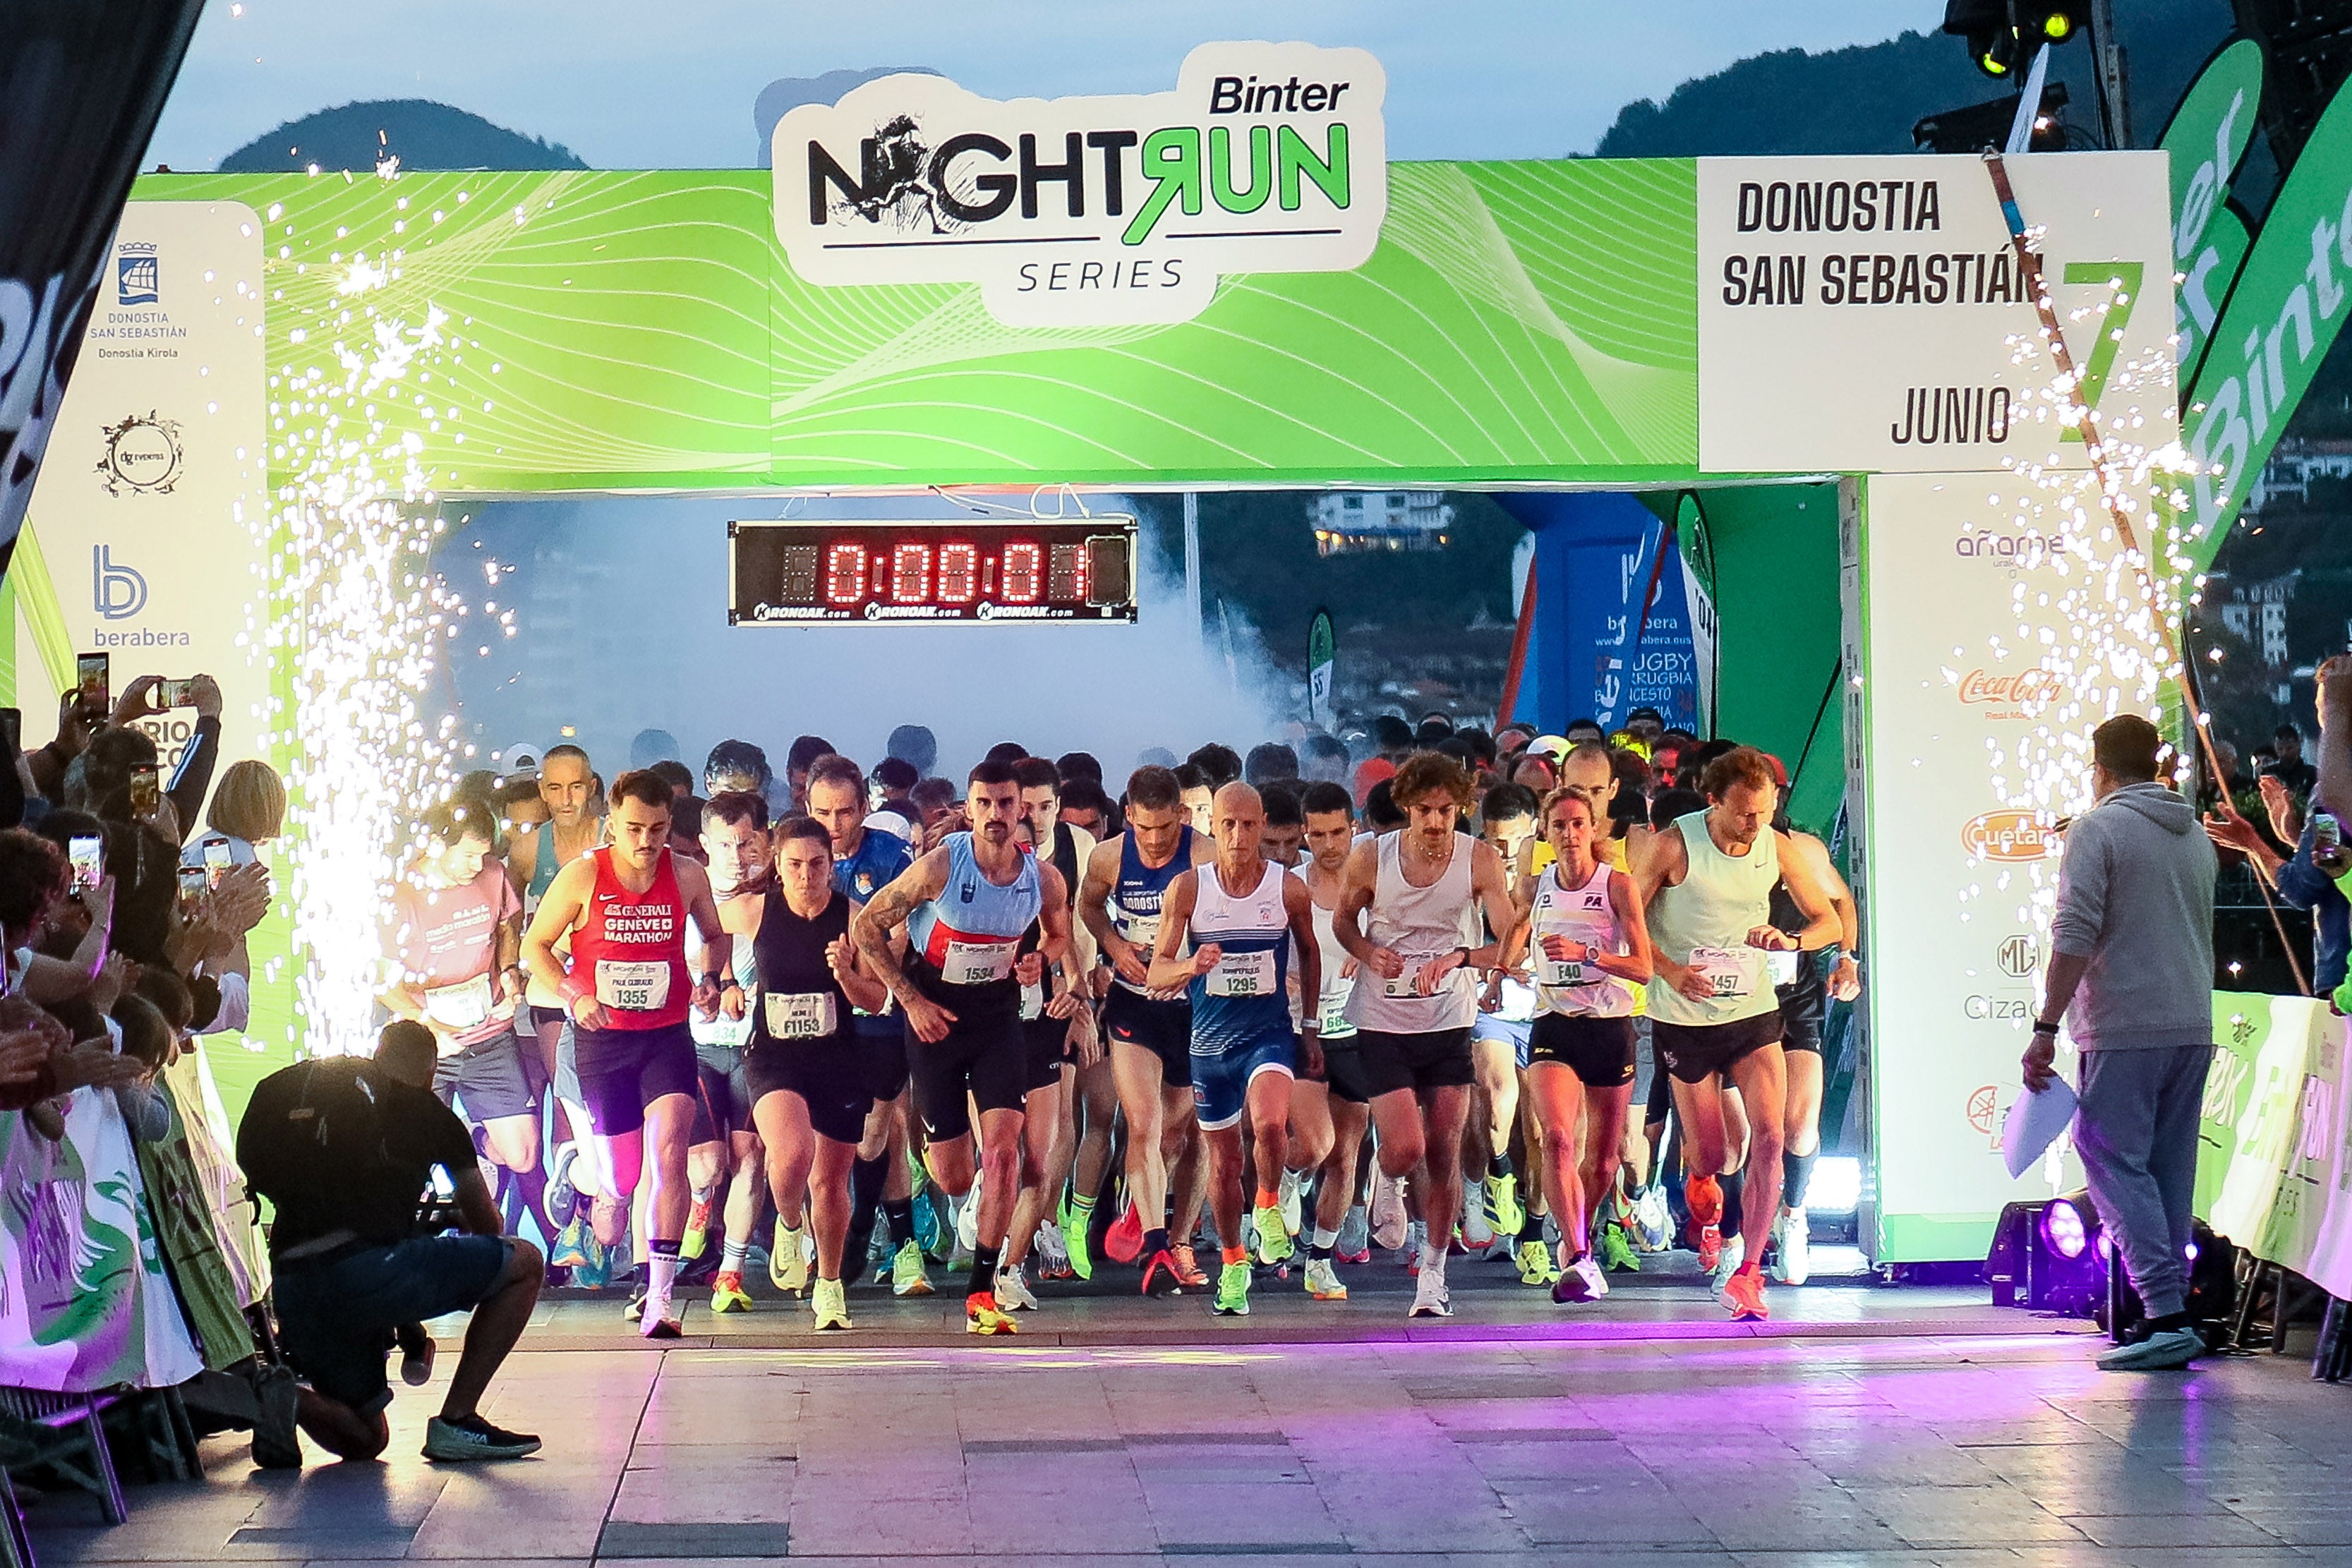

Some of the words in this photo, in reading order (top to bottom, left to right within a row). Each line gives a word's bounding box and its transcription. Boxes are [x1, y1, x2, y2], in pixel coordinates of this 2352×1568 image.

[1210, 76, 1349, 114] Binter
[1737, 181, 1940, 231] DONOSTIA
[1018, 259, 1183, 291] SERIES
[1723, 255, 1806, 305] SAN
[1821, 243, 2044, 304] SEBASTIÁN
[109, 313, 169, 323] DONOSTIA
[90, 328, 115, 338] SAN
[119, 325, 186, 338] SEBASTIÁN
[99, 348, 143, 358] Donostia
[147, 348, 178, 358] Kirola
[2058, 262, 2145, 442] 7
[1892, 387, 2010, 444] JUNIO
[95, 627, 189, 646] berabera
[1633, 653, 1691, 670] UGBY
[1970, 826, 2061, 846] Cuétar
[622, 905, 672, 916] GENERALI
[604, 916, 661, 931] GENÈVE
[604, 931, 673, 943] MARATHON
[2001, 939, 2036, 973] MG
[1557, 964, 1581, 979] F40
[1226, 977, 1258, 992] 1295
[1709, 975, 1738, 989] 1457
[617, 989, 648, 1005] 1355
[713, 1027, 737, 1040] 834
